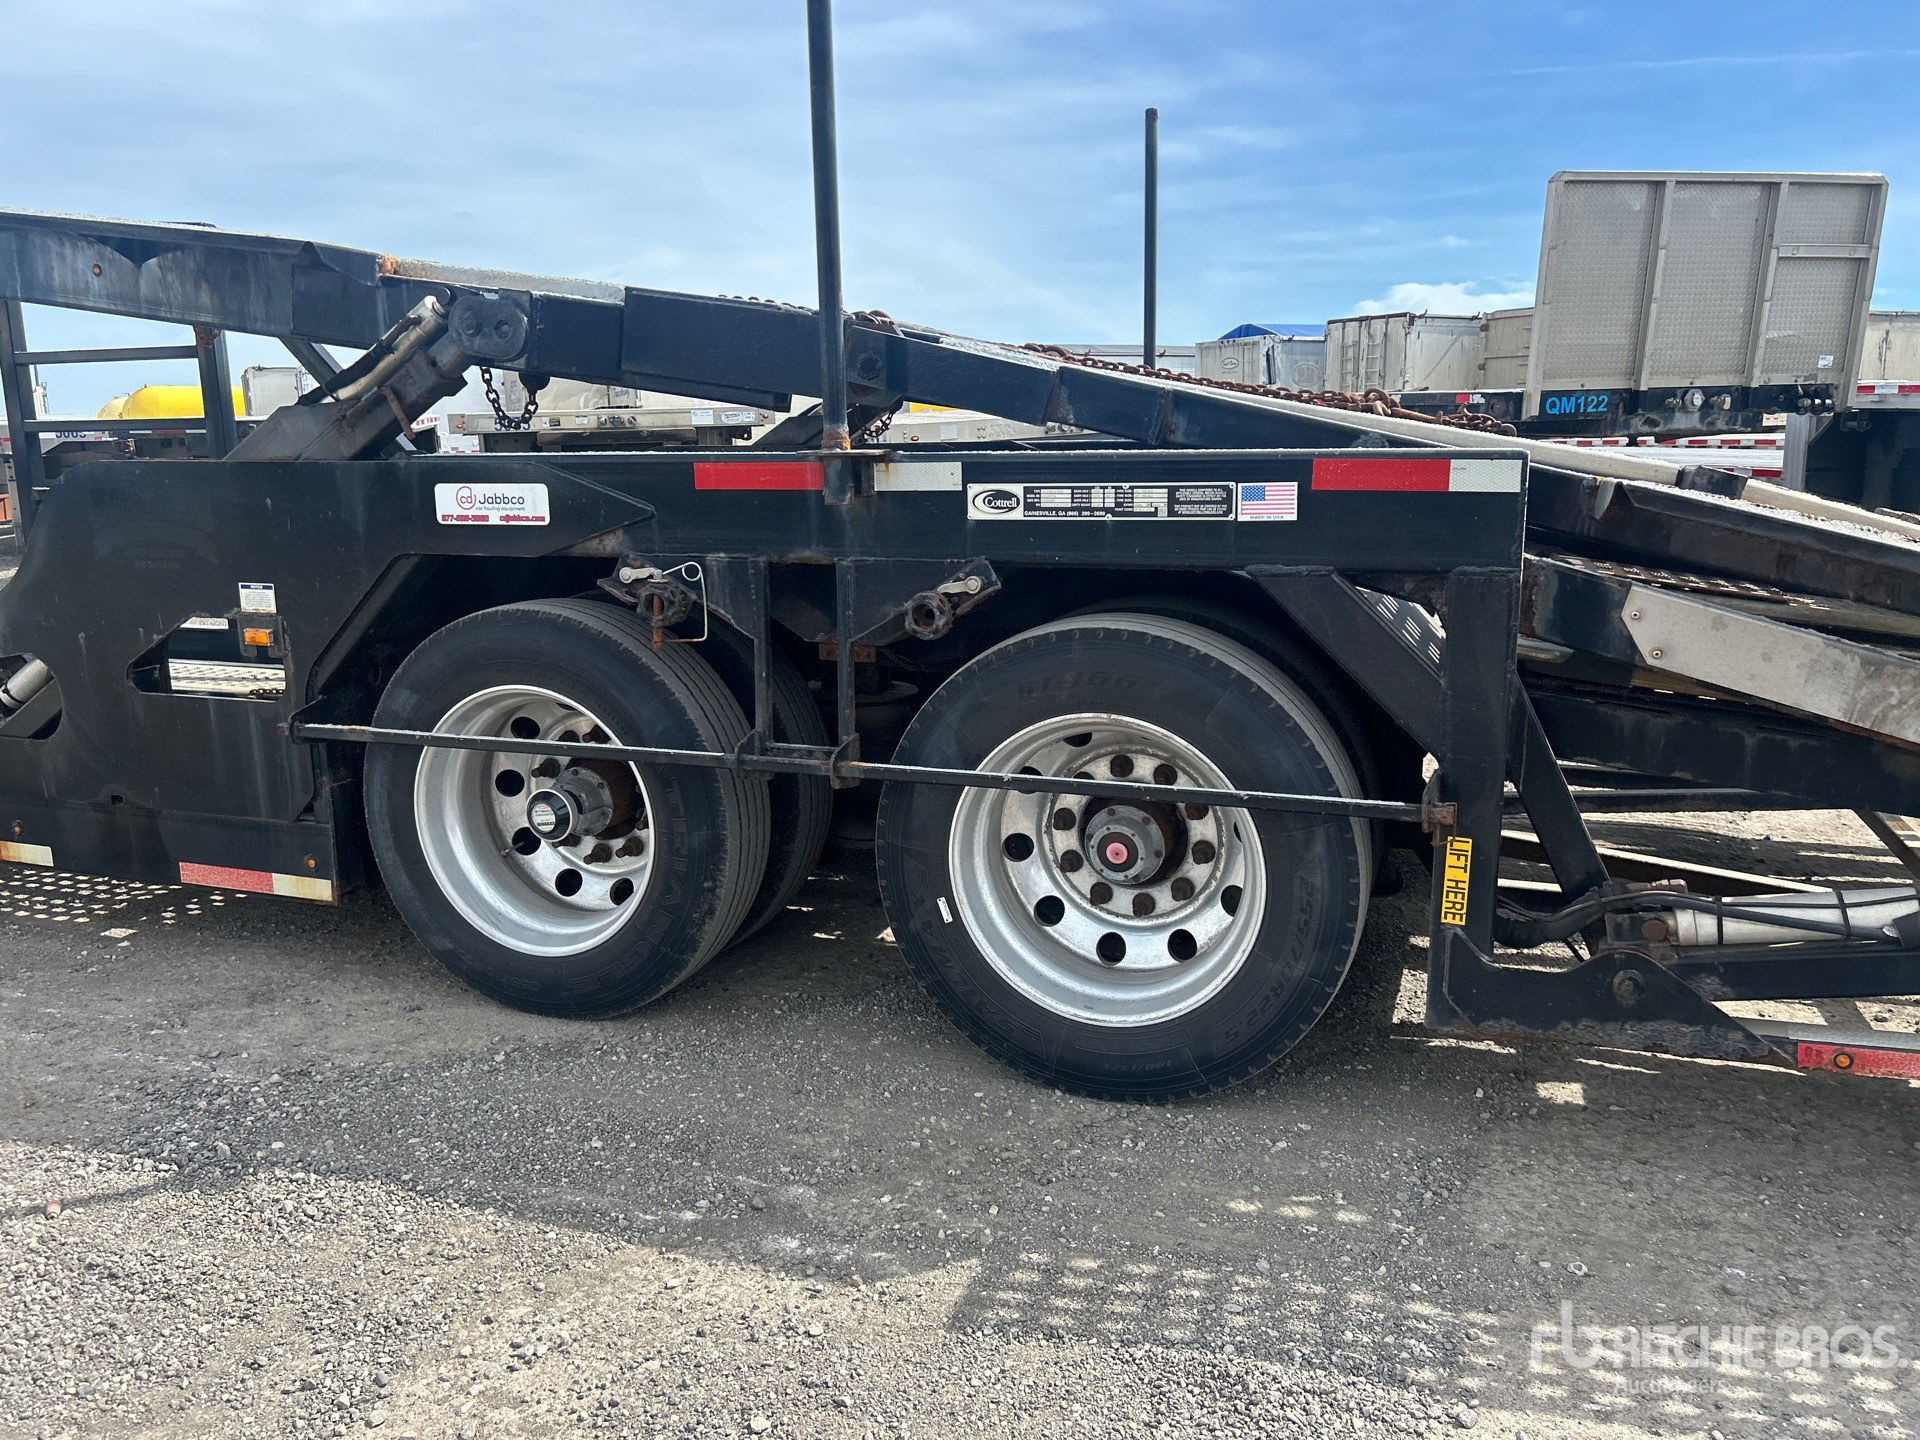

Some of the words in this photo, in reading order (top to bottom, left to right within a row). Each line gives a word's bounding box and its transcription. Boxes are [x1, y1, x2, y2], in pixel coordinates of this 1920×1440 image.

[1545, 394, 1608, 415] QM122
[478, 493, 525, 505] Jabbco
[985, 496, 1017, 508] Cottrell
[1448, 839, 1470, 873] LIFT
[1443, 879, 1466, 922] HERE
